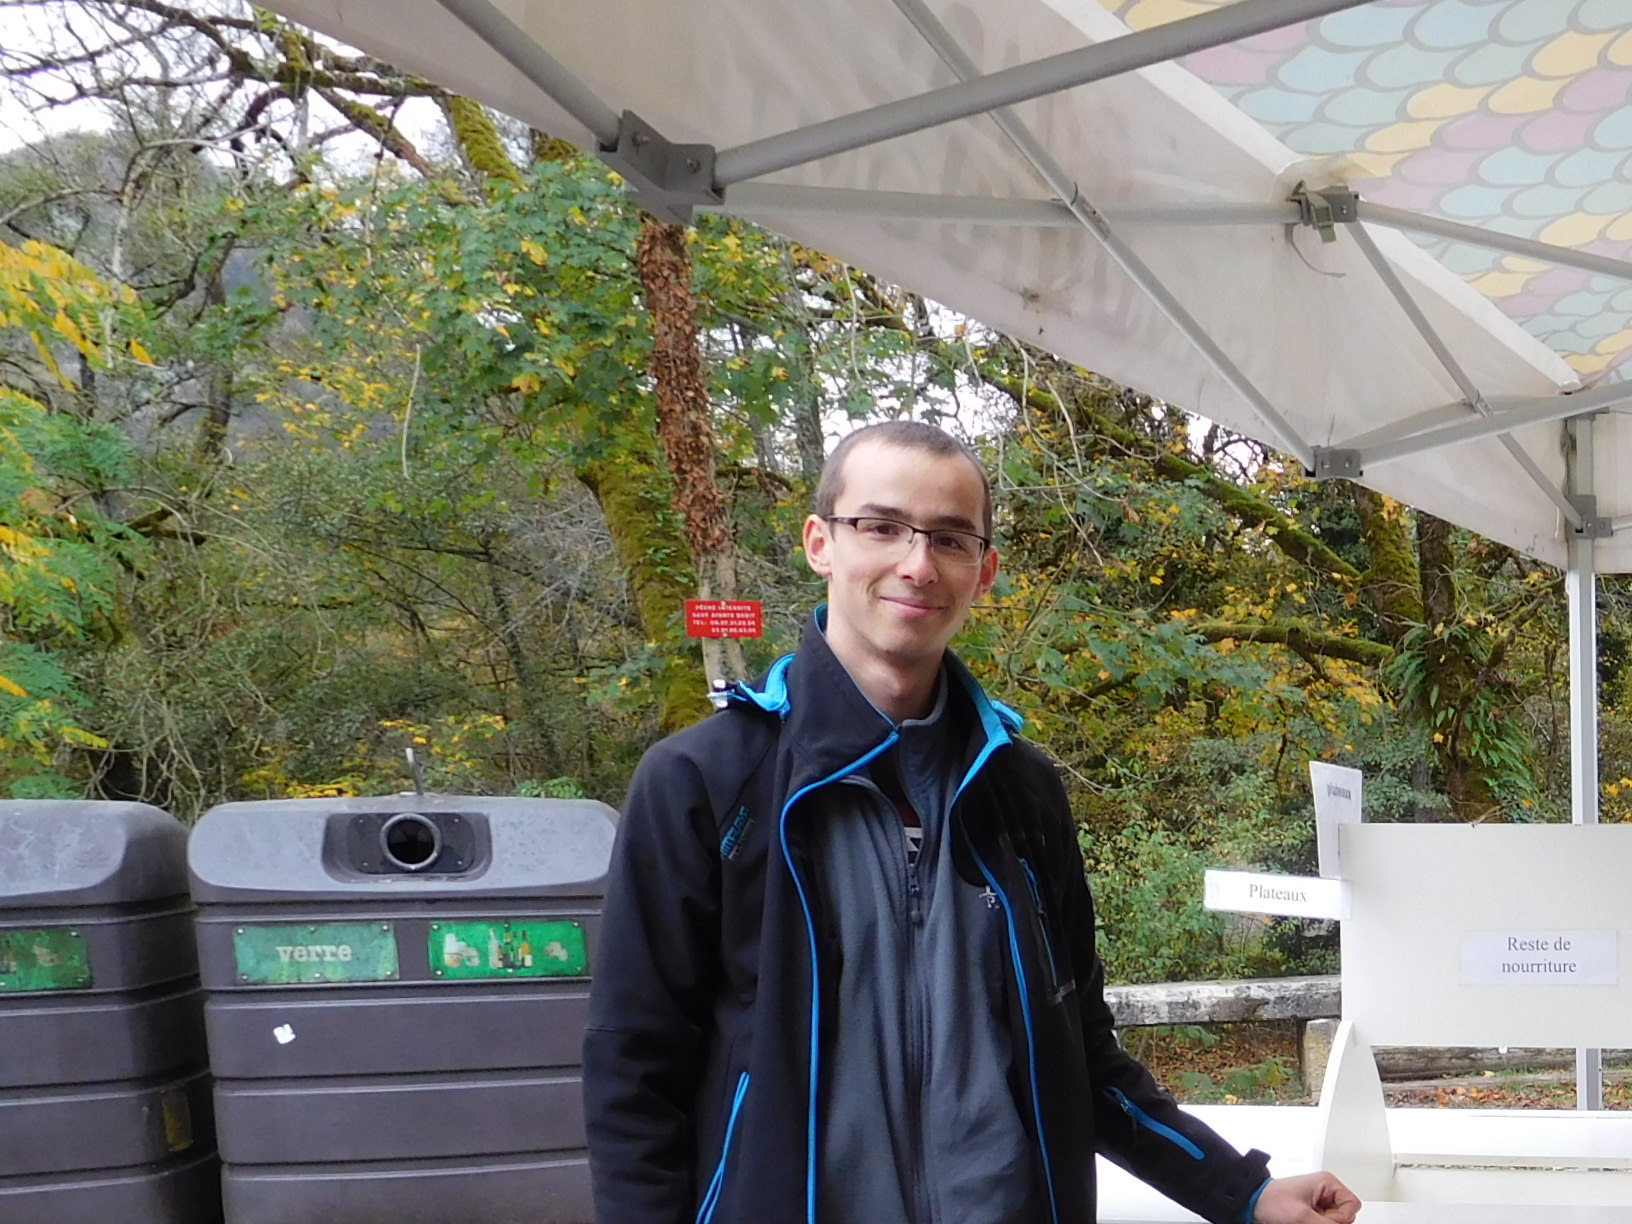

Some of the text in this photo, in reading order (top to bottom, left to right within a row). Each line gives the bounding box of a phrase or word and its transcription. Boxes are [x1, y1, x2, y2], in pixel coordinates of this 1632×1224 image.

[1248, 883, 1308, 903] Plateaux
[275, 943, 353, 962] verre
[1507, 936, 1572, 952] Reste de
[1501, 958, 1577, 974] nourriture
